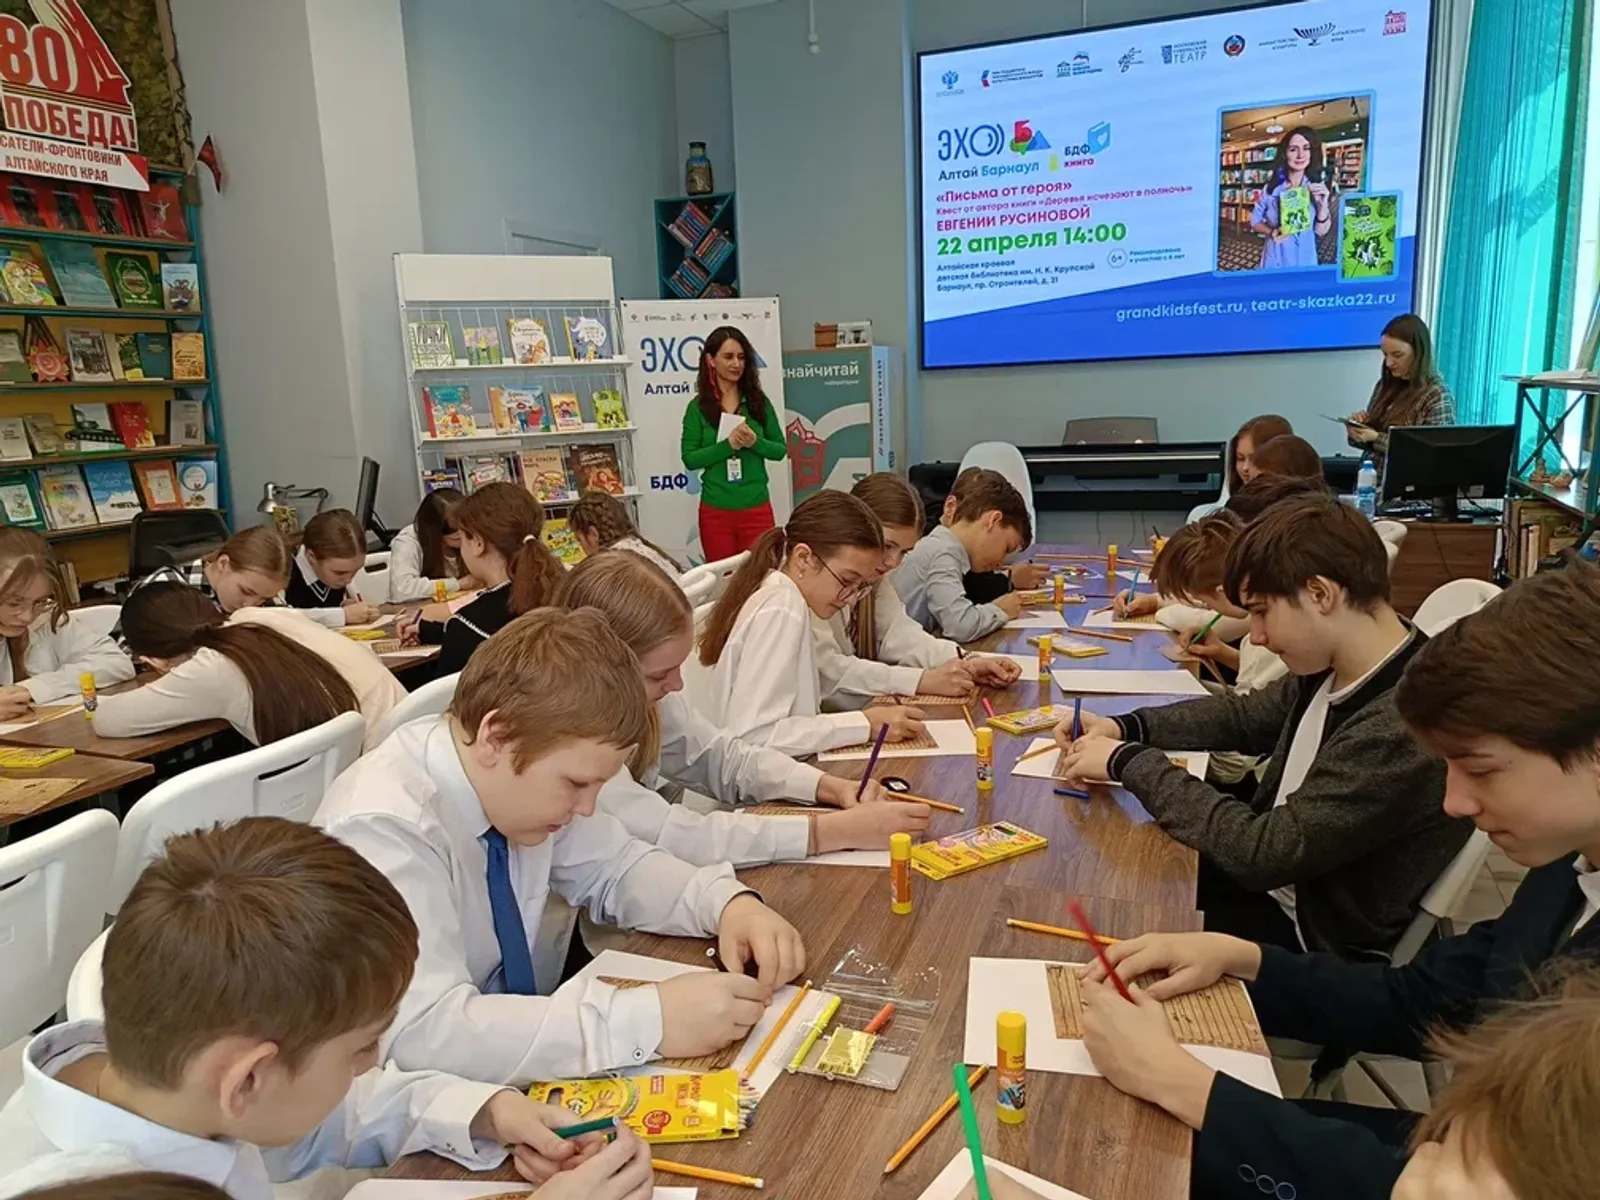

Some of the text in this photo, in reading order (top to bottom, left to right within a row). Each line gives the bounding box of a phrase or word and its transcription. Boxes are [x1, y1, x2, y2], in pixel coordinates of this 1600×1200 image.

[0, 15, 72, 93] 80
[1174, 51, 1208, 64] ТЕАТР
[3, 94, 137, 149] ПОБЕДА!
[1064, 143, 1091, 157] БДФ
[5, 155, 109, 183] АЛТАЙСКОГО КРАЯ
[938, 161, 1040, 181] Алтай Барнаул
[936, 181, 1073, 203] «Письма от героя»
[936, 205, 962, 216] Квест
[963, 205, 975, 214] от
[975, 202, 1010, 213] автора
[1011, 200, 1038, 210] книги
[1086, 189, 1135, 201] исчезают
[936, 203, 1091, 232] ЕВГЕНИИ РУСИНОВОЙ
[937, 222, 1128, 256] 22 апреля 14:00
[936, 259, 1016, 272] Алтайская краевая
[1110, 253, 1123, 264] 6+
[936, 273, 969, 283] детская
[970, 269, 1019, 280] библиотека
[1054, 262, 1096, 274] Крупской
[1115, 292, 1397, 323] grandkidsfest.ru, teatr-skazka22.ru
[644, 381, 691, 395] Алтай
[650, 473, 690, 490] БДФ
